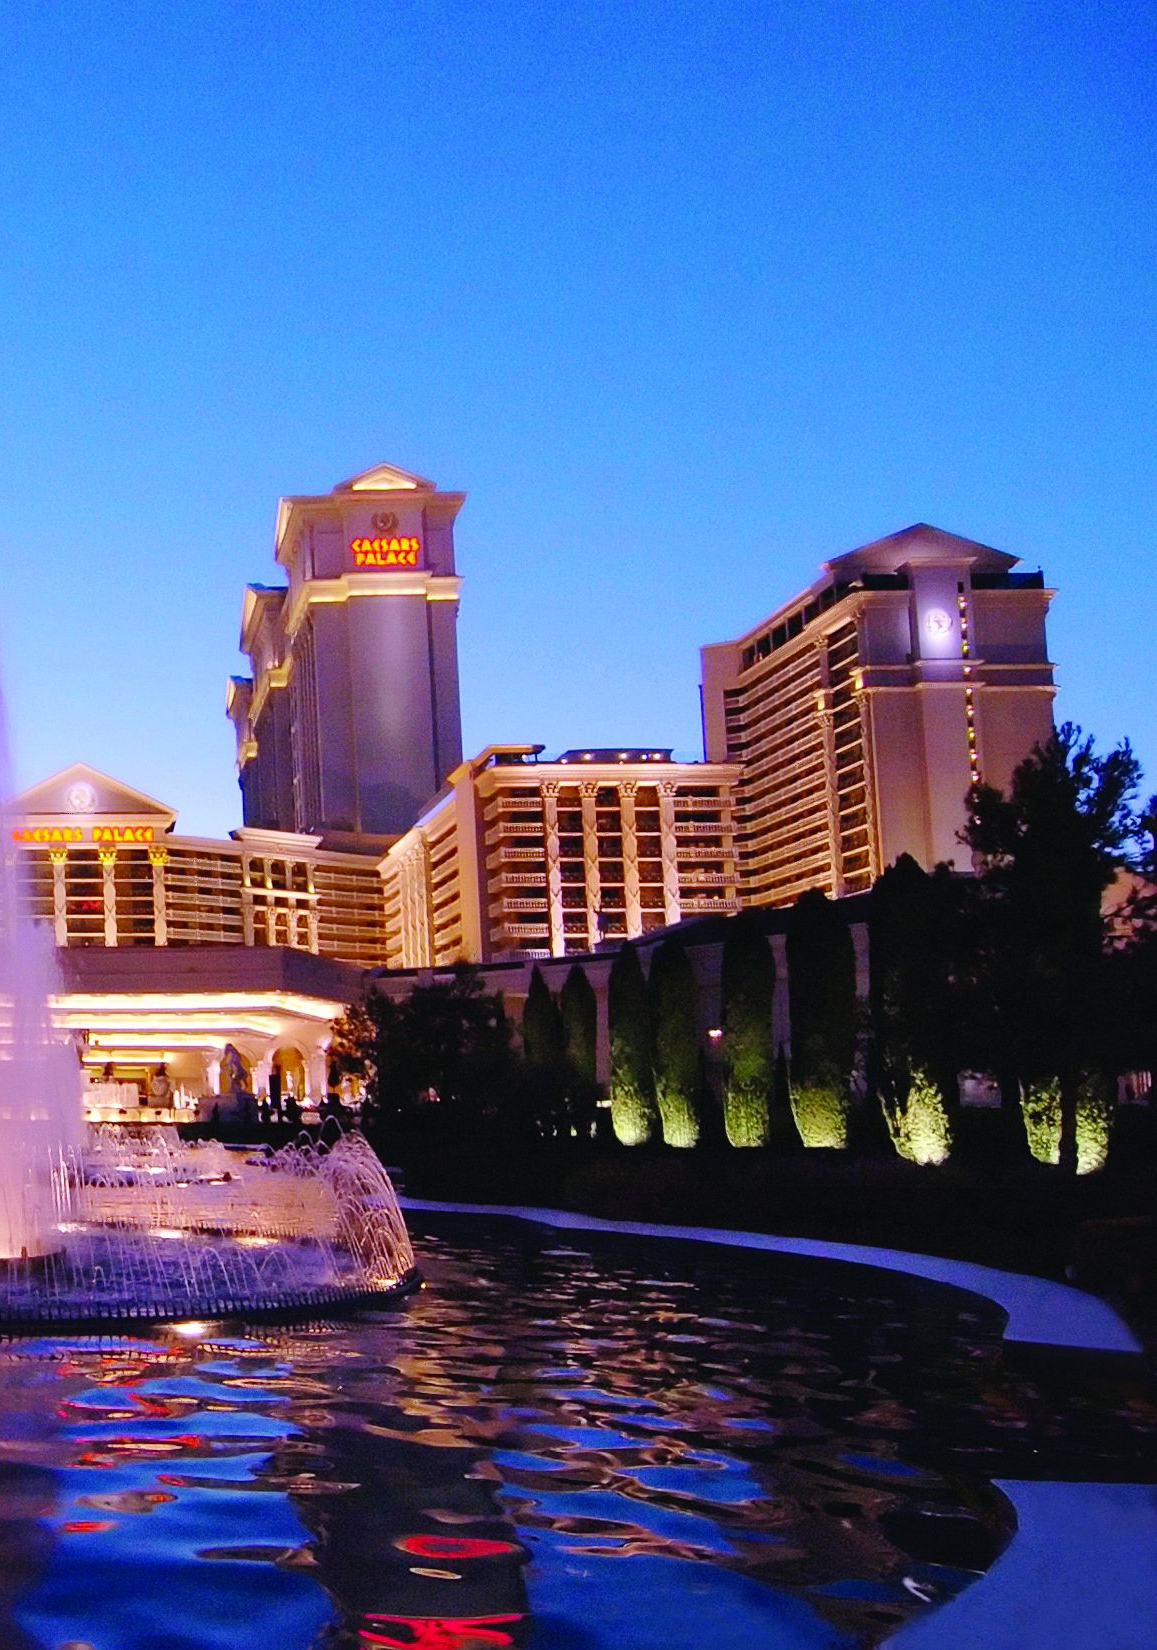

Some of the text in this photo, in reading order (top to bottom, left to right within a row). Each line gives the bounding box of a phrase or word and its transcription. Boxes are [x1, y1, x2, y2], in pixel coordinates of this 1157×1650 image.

[350, 536, 420, 552] CAESARS
[354, 551, 417, 566] PALACE
[12, 826, 154, 842] CAESARS PALACE
